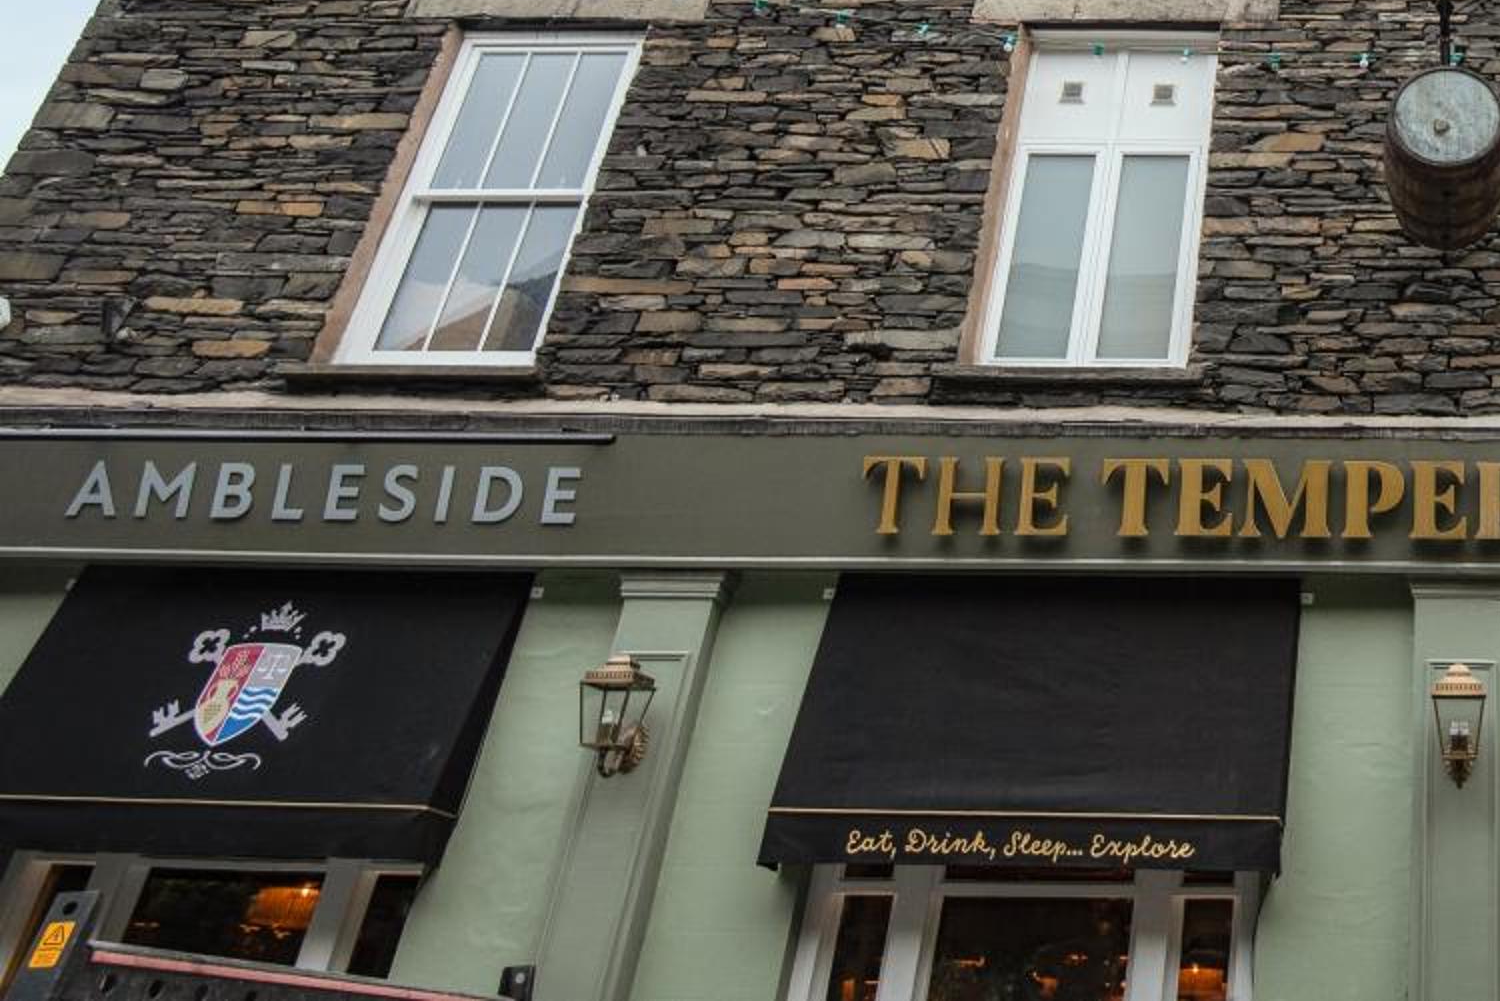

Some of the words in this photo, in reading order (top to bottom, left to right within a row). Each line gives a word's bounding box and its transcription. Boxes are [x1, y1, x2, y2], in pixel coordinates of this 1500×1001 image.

[64, 460, 582, 525] AMBLESIDE
[863, 455, 1071, 537] THE
[846, 830, 897, 858] Eat,
[905, 828, 997, 861] Drink,
[1003, 831, 1084, 864] Sleep...
[1090, 834, 1195, 864] Explore
